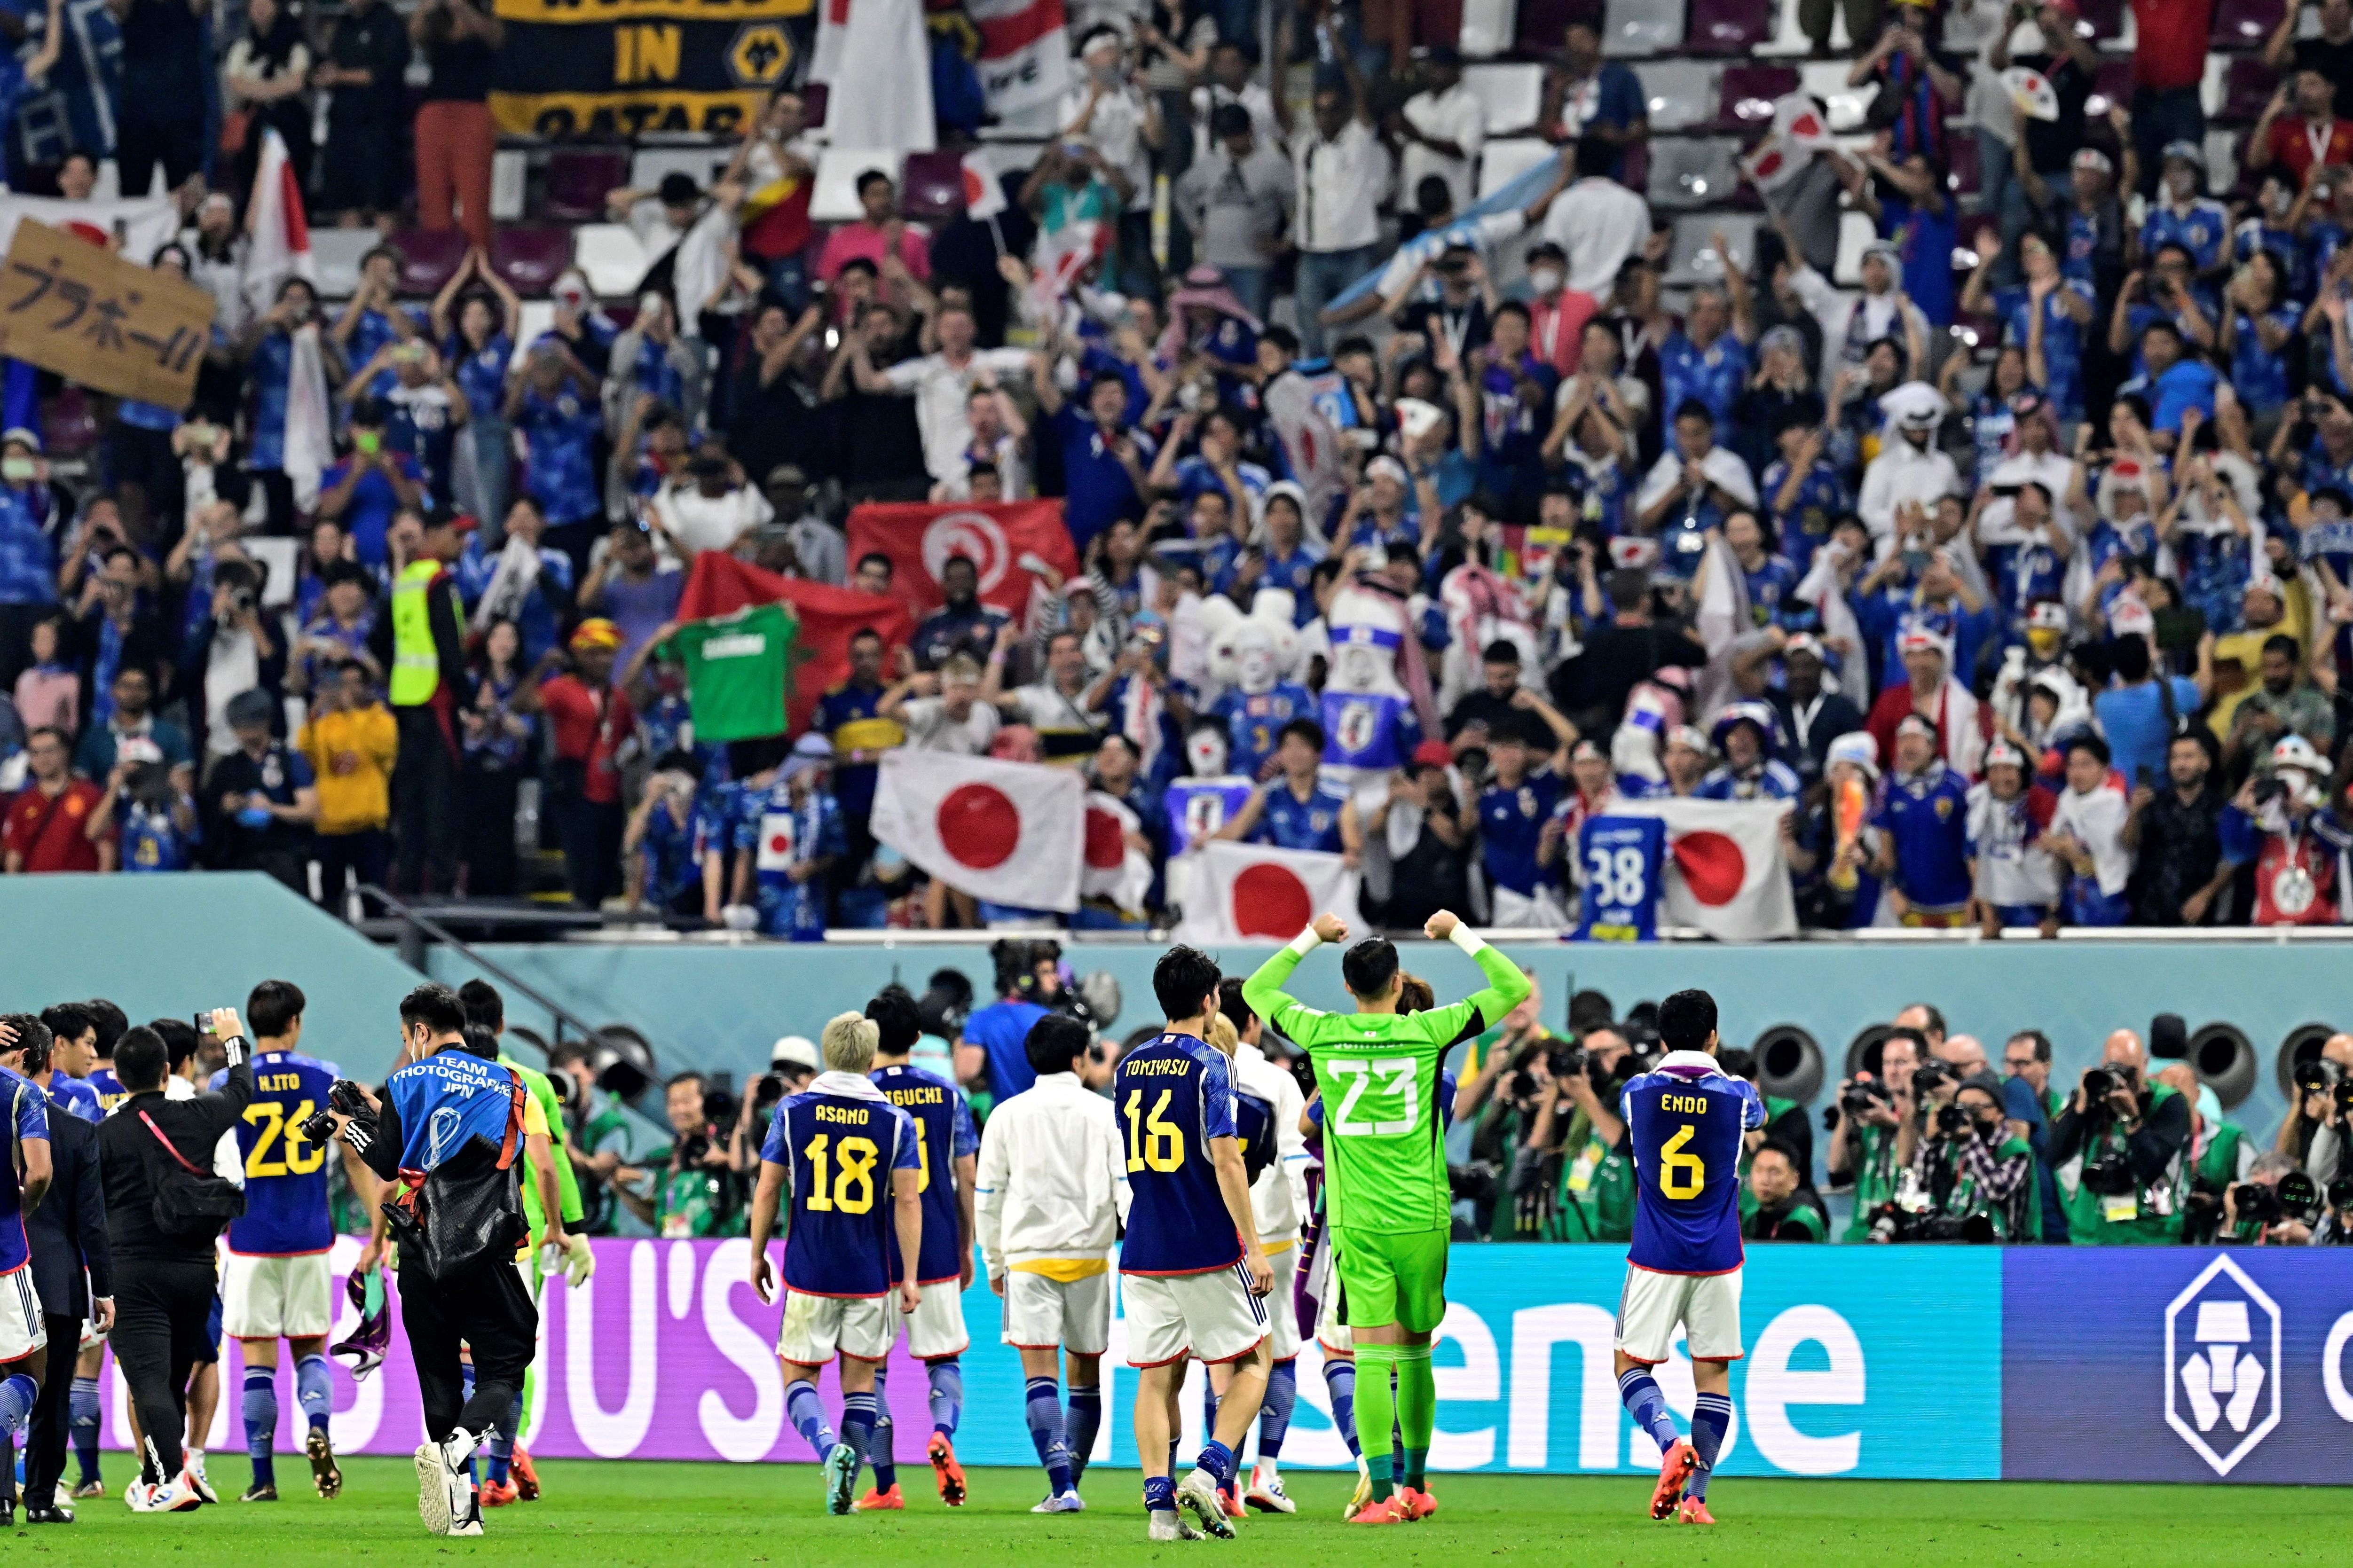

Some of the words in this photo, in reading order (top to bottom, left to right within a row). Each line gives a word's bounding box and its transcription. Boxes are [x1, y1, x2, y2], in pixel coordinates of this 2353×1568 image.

[614, 23, 682, 83] IN
[1588, 846, 1645, 907] 38
[393, 1066, 513, 1098] PHOTOGRAPHE
[436, 1057, 488, 1076] TEAM
[1125, 1059, 1190, 1077] TOMIYASU
[443, 1082, 475, 1099] JPN
[883, 1087, 944, 1106] IGUCHI
[1327, 1057, 1419, 1136] 23
[1661, 1093, 1708, 1114] ENDO
[815, 1104, 869, 1125] ASANO
[1123, 1089, 1185, 1173] 16
[242, 1098, 325, 1179] 26
[803, 1133, 879, 1215] 18
[1660, 1124, 1705, 1200] 6
